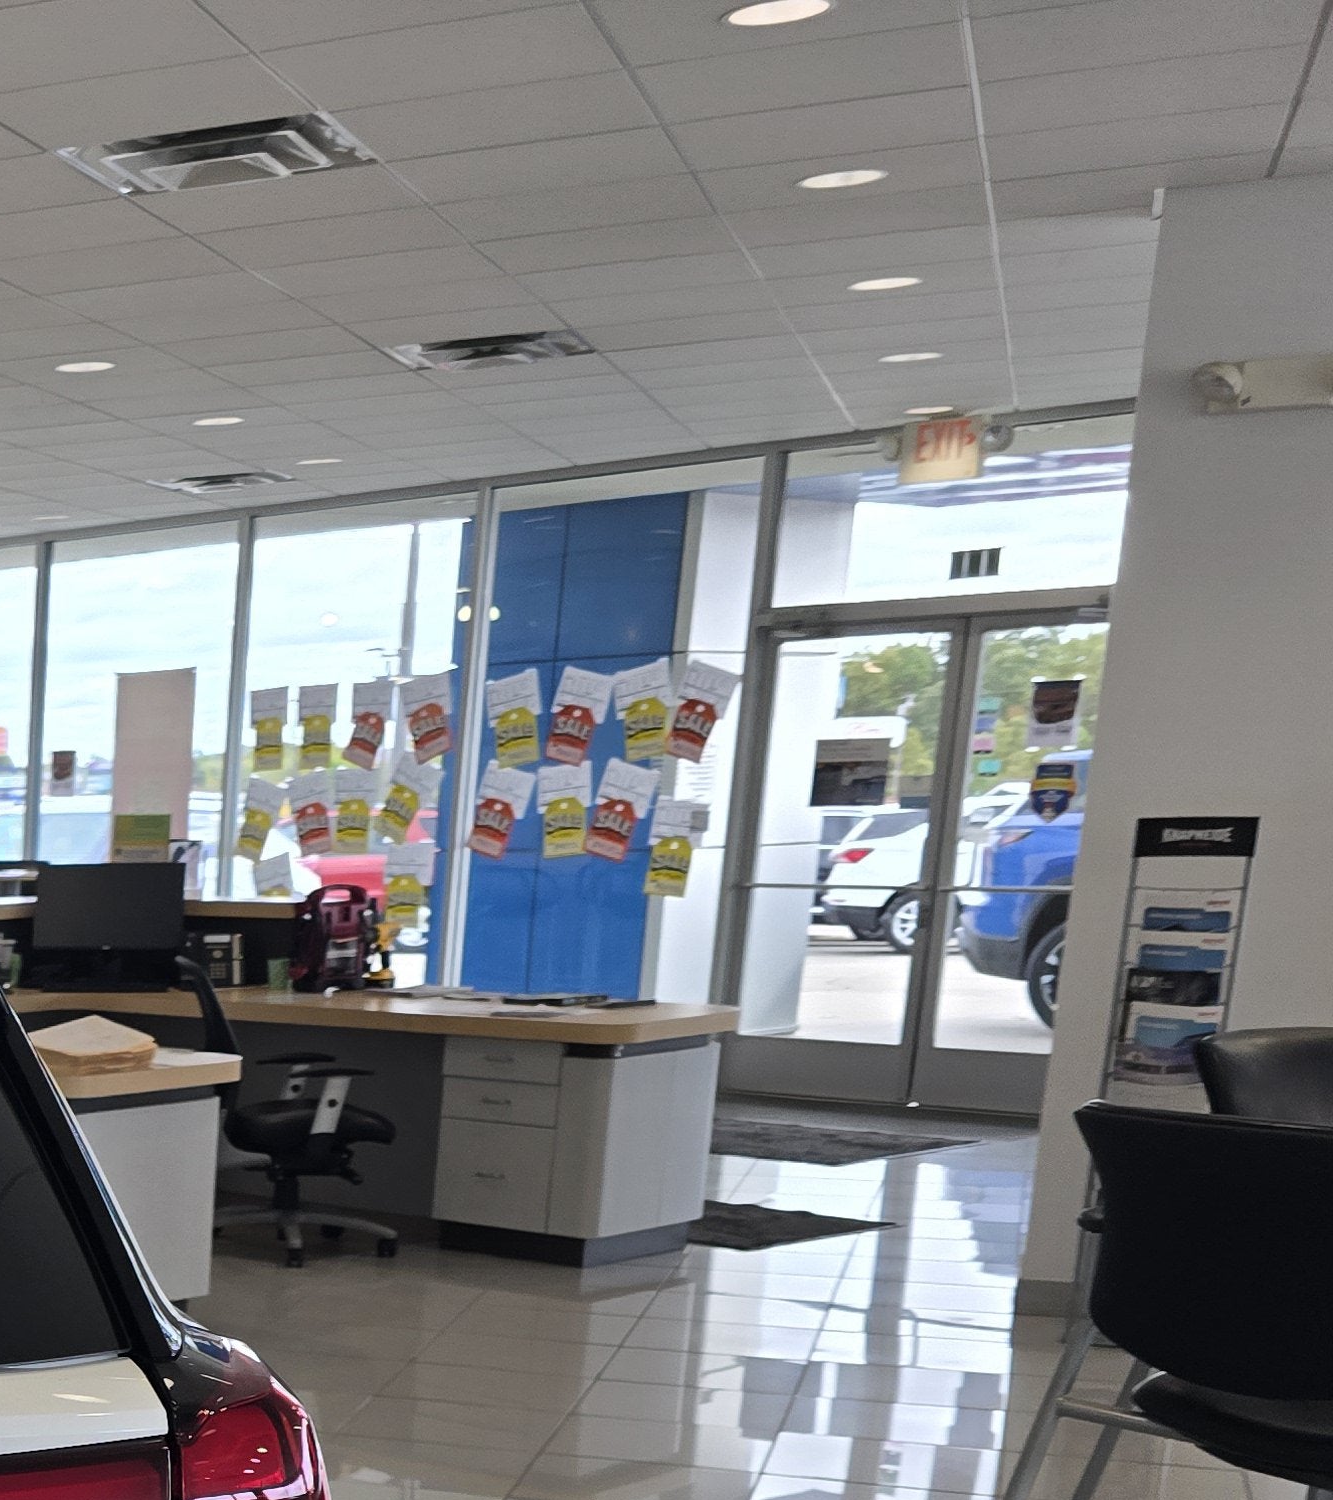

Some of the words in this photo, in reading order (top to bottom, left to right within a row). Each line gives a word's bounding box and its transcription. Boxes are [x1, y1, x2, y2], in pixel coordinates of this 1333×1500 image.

[497, 723, 534, 742] SALE
[556, 716, 592, 741] SALE
[625, 716, 664, 736] SALE
[674, 714, 713, 738] SALE
[475, 809, 511, 833] SALE
[545, 813, 584, 830] SALE
[593, 811, 633, 836] SALE
